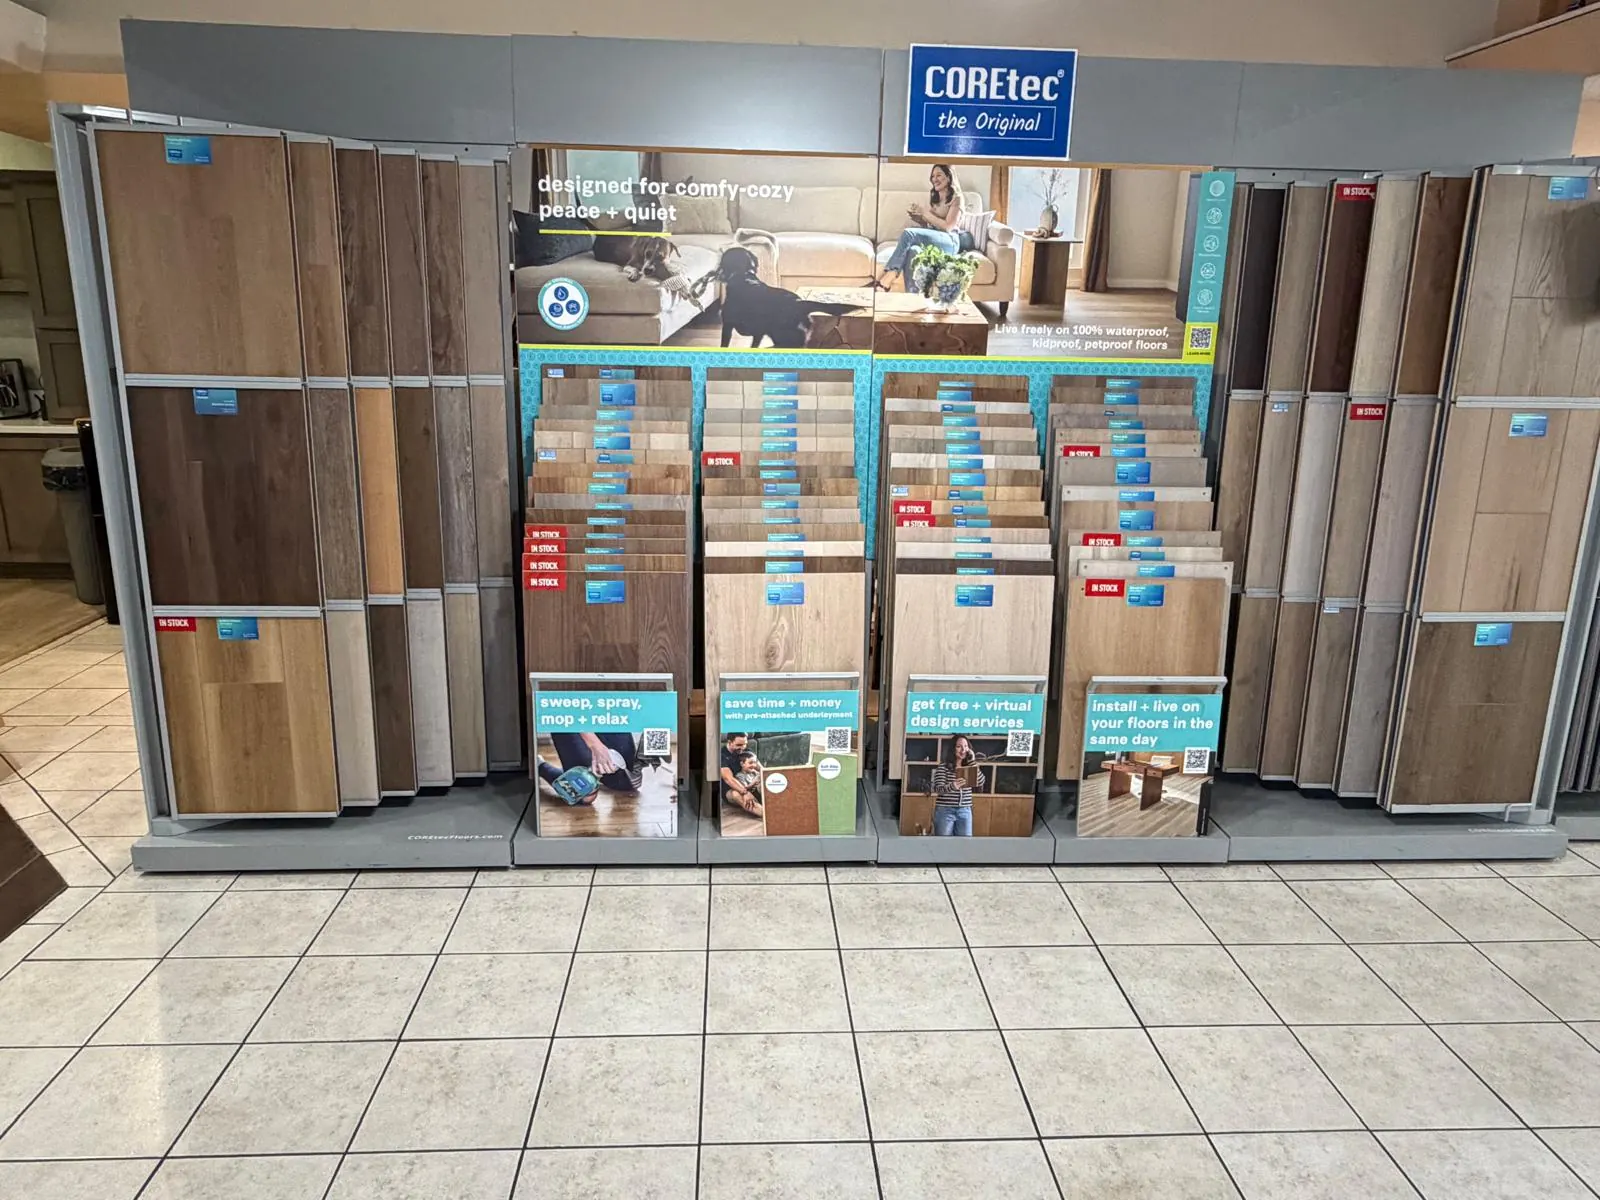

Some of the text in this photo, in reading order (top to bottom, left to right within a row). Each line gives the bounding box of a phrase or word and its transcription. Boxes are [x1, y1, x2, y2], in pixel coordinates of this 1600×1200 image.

[938, 110, 1041, 137] the Original
[537, 174, 795, 203] designed for comfy-cozy
[1343, 187, 1371, 196] IN STOCK
[538, 202, 677, 224] peace + quiet
[994, 323, 1170, 339] Live freely on 100% waterproof,
[1032, 338, 1168, 351] kidproof, petproof floors
[1356, 407, 1384, 416] IN STOCK
[707, 457, 734, 466] IN STOCK
[898, 505, 926, 514] IN STOCK
[530, 544, 559, 553] IN STOCK
[1088, 538, 1115, 546] IN STOCK
[530, 561, 559, 570] IN STOCK
[530, 578, 559, 587] IN STOCK
[1091, 583, 1119, 593] IN STOCK
[158, 618, 190, 627] IN STOCK
[540, 697, 642, 710] sweep, spray,
[724, 697, 842, 710] save time + money
[911, 697, 1032, 713] get free + virtual
[1092, 699, 1200, 713] install + live on
[541, 712, 629, 727] mop + relax
[724, 711, 853, 721] with pre-attached underlayment
[910, 714, 1024, 729] design services
[1091, 716, 1214, 731] your floors in the
[1089, 733, 1158, 748] same day
